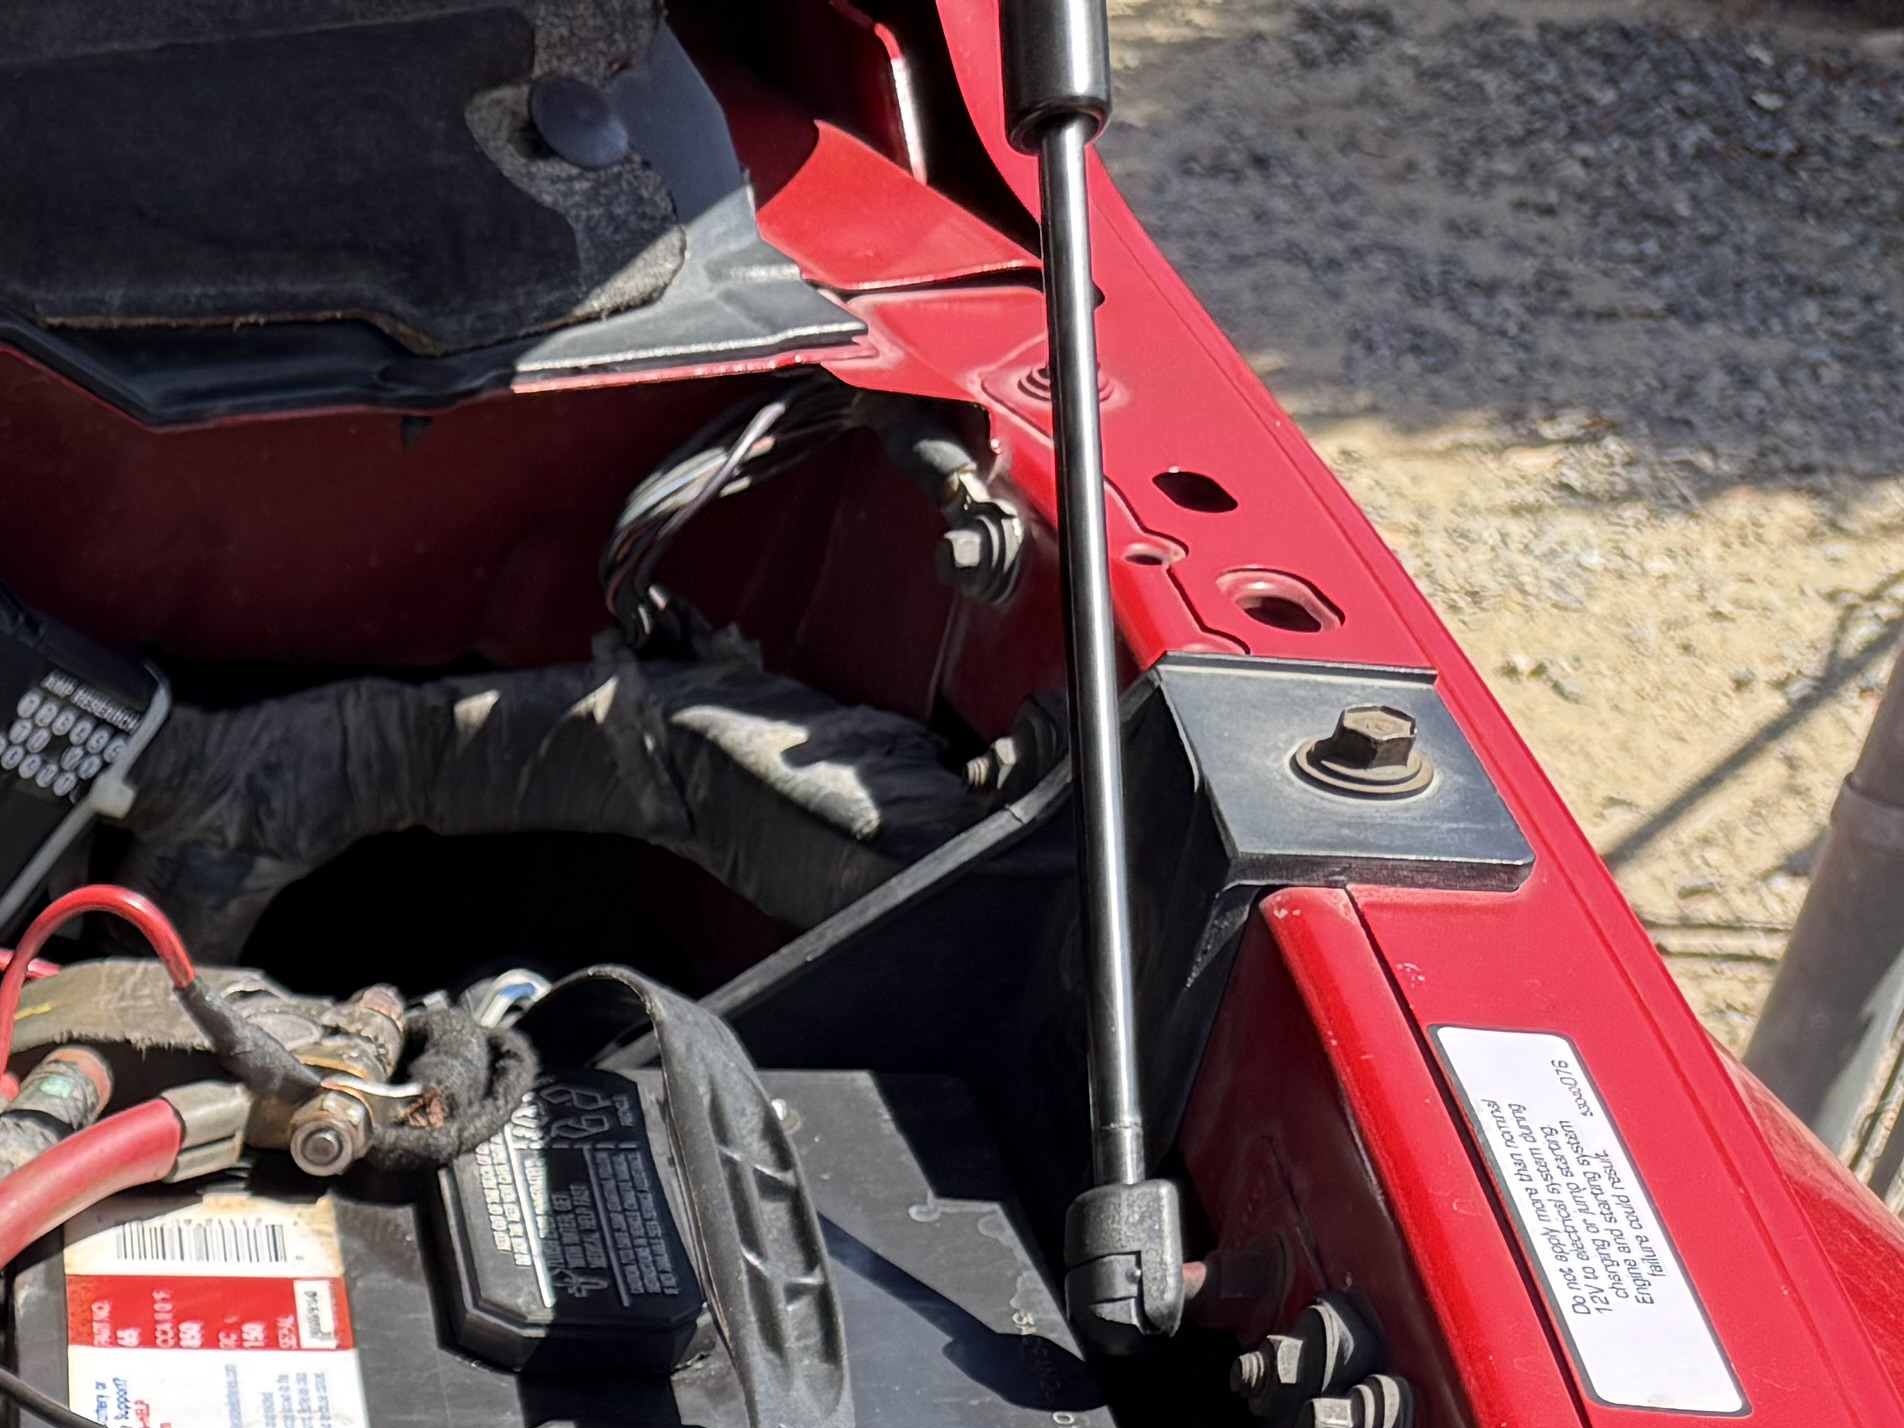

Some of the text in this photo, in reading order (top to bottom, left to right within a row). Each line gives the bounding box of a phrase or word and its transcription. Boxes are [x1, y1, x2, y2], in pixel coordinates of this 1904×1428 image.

[1505, 1152, 1532, 1181] than
[1505, 1103, 1614, 1314] 12V to electrical system during
[1523, 1187, 1551, 1221] more
[1557, 1120, 1660, 1304] Engine and starting system
[1562, 1182, 1598, 1215] jump
[1611, 1194, 1644, 1229] could
[1581, 1219, 1600, 1232] or
[1538, 1226, 1572, 1261] apply
[1630, 1234, 1667, 1276] failure
[1557, 1266, 1581, 1290] not
[1588, 1237, 1635, 1298] charging
[1566, 1294, 1592, 1314] Do
